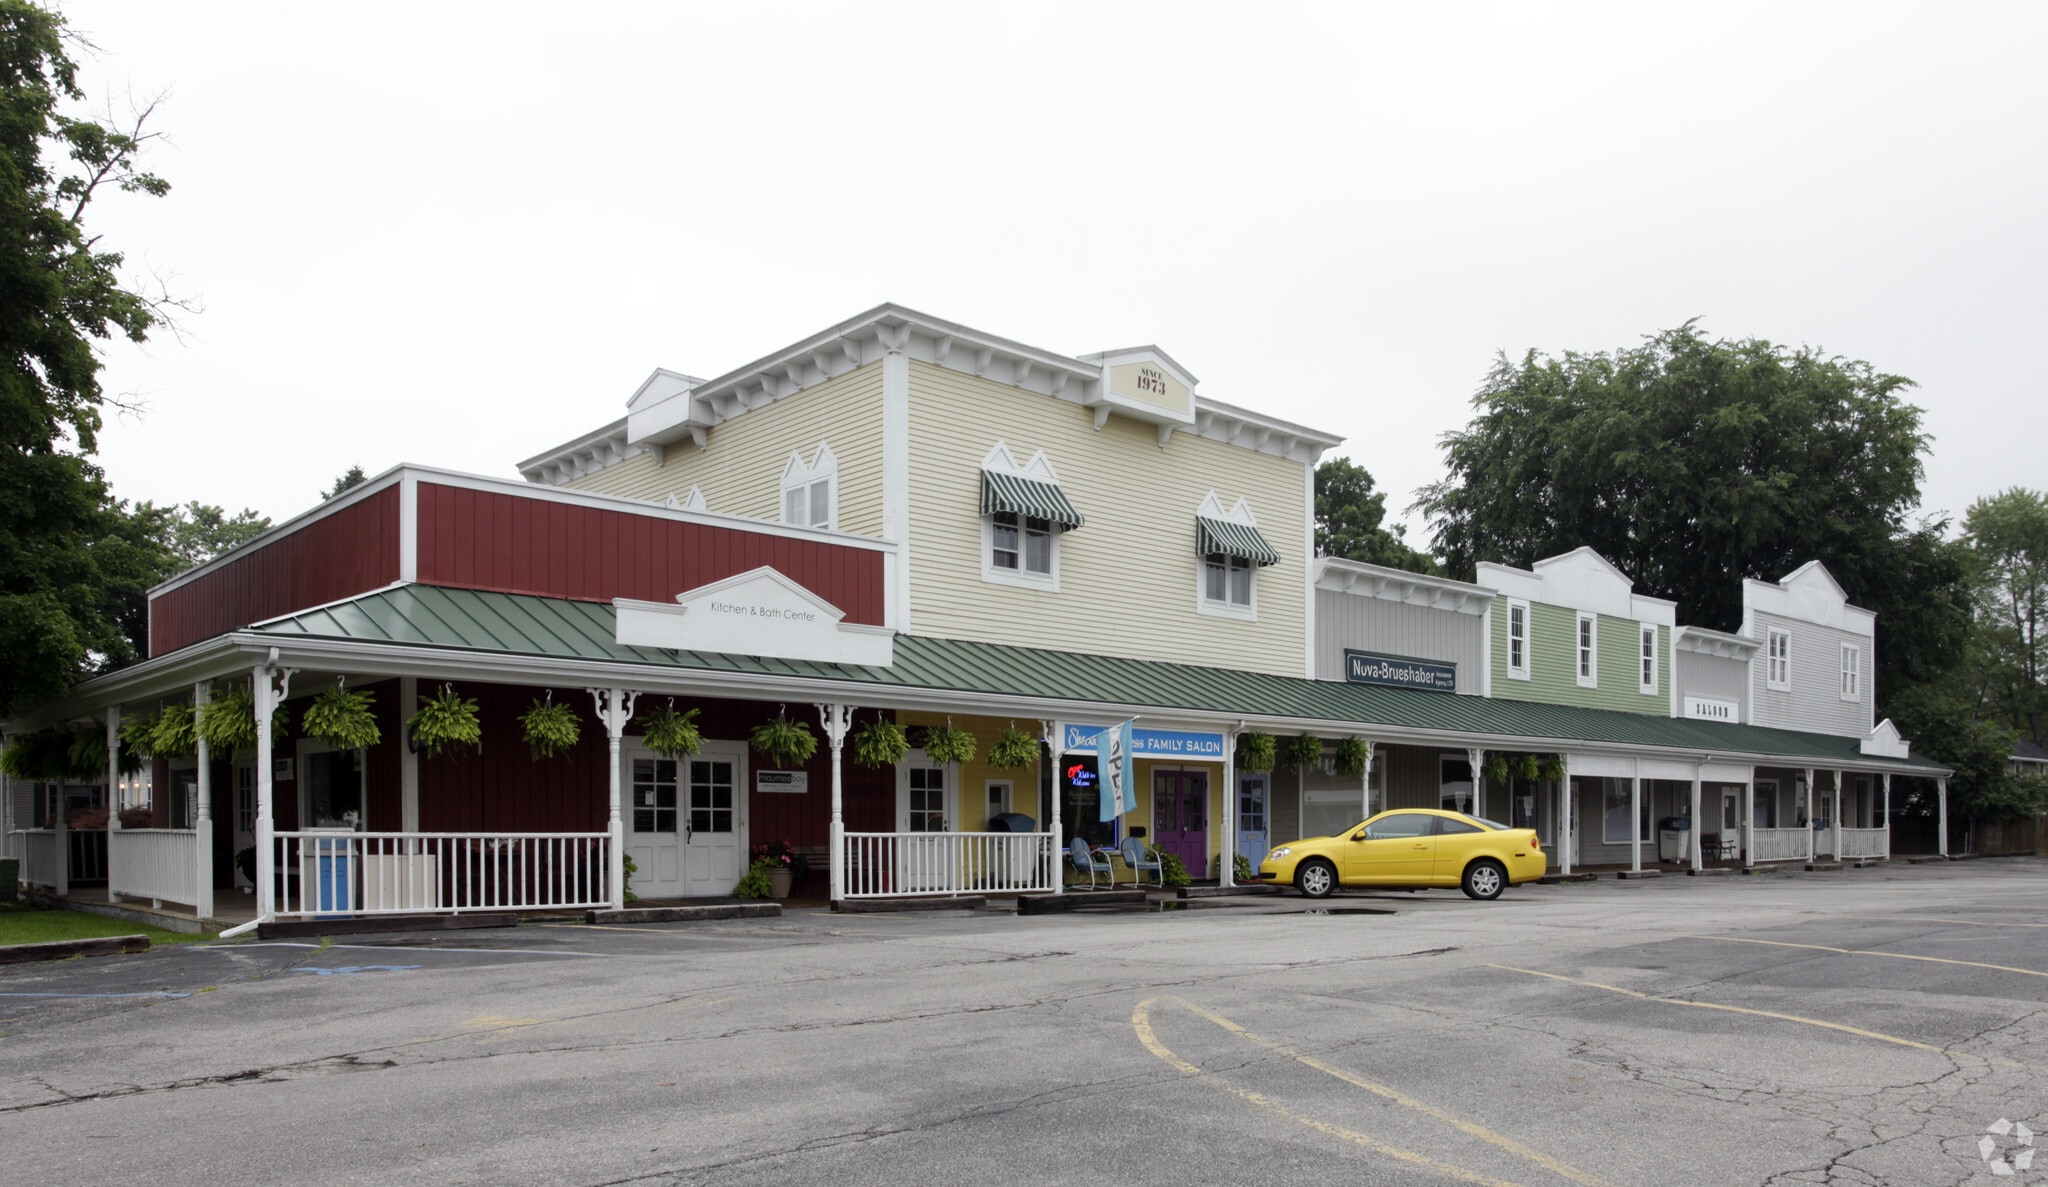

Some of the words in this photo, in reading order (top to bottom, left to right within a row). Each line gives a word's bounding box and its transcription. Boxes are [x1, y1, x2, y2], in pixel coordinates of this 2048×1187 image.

[1141, 368, 1162, 380] SINCE
[1137, 375, 1166, 395] 1973
[711, 601, 747, 615] Kitchen
[750, 606, 757, 616] &
[760, 607, 780, 618] Bath
[784, 609, 815, 622] Center
[1353, 659, 1435, 684] Nova-Brueshaber
[1696, 703, 1728, 718] SALOON
[1148, 738, 1184, 751] FAMILY
[1186, 740, 1220, 753] SALON
